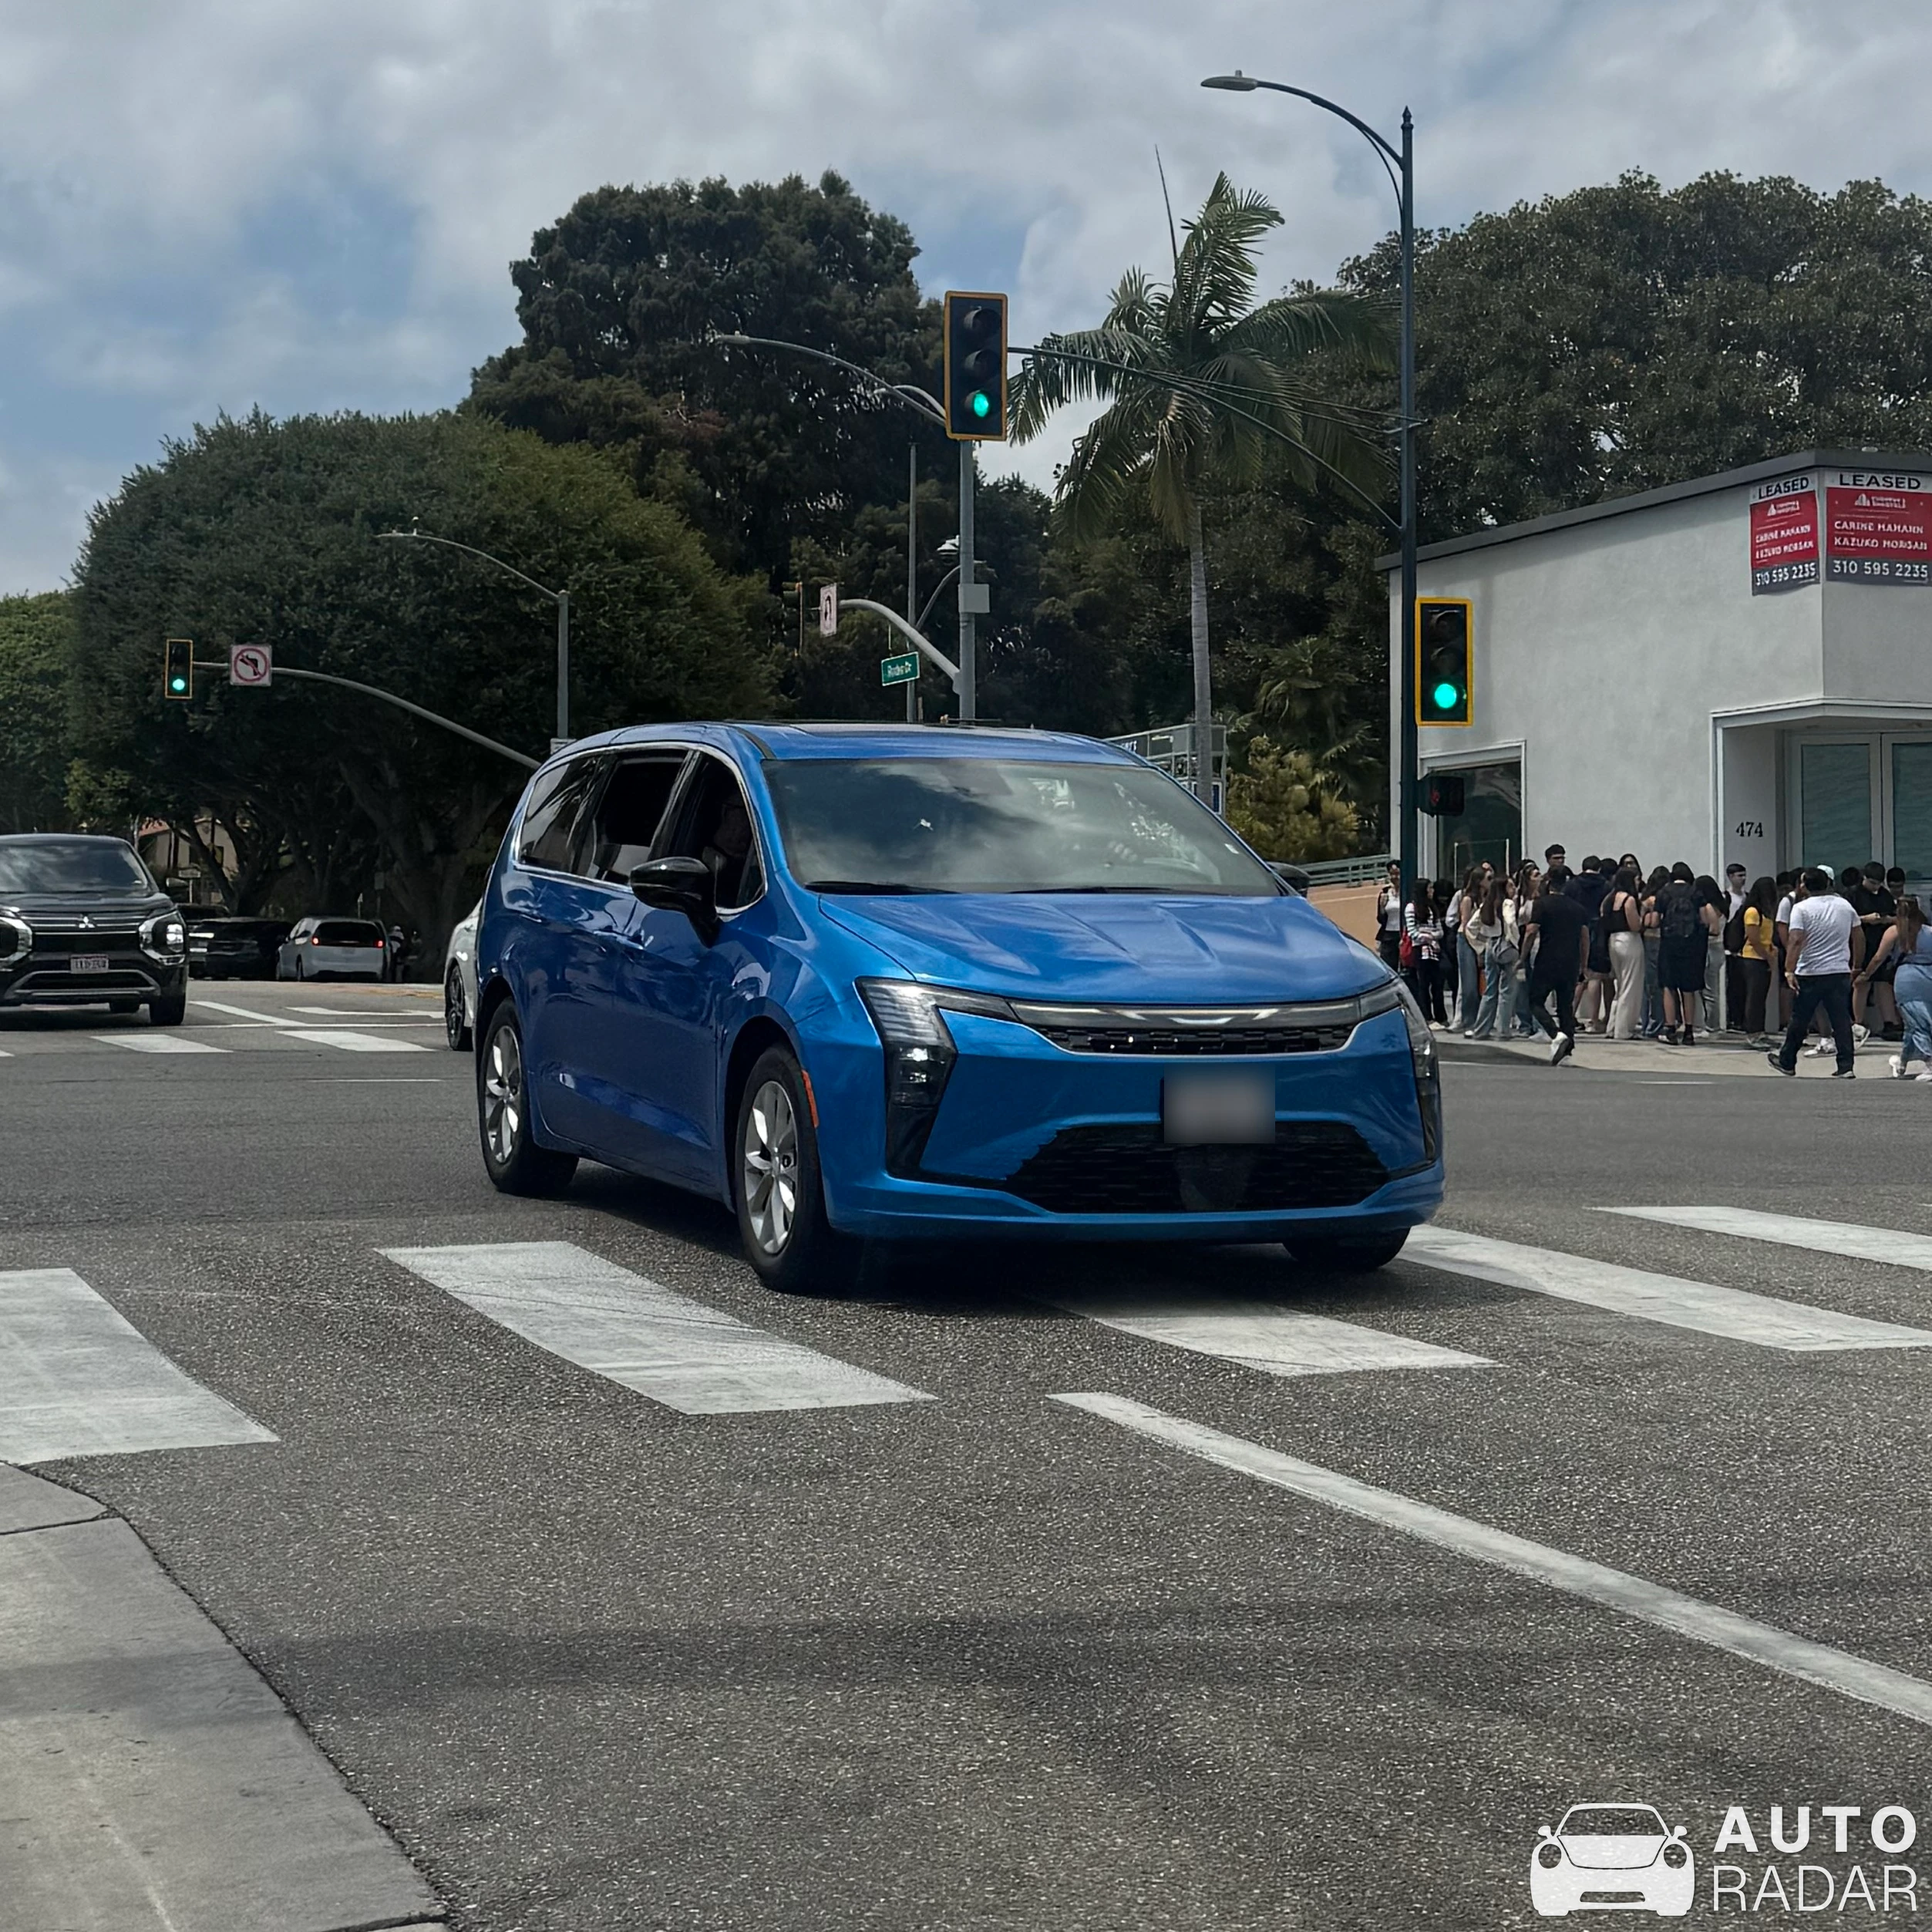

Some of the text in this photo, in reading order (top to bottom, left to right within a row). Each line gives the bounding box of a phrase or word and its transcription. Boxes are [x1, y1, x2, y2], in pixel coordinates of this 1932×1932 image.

[1759, 476, 1809, 500] LEASED
[1839, 473, 1921, 490] LEASED
[1755, 571, 1770, 586] 310
[1772, 567, 1789, 583] 595
[1833, 560, 1928, 578] 310 595 2235
[1735, 821, 1764, 838] 474
